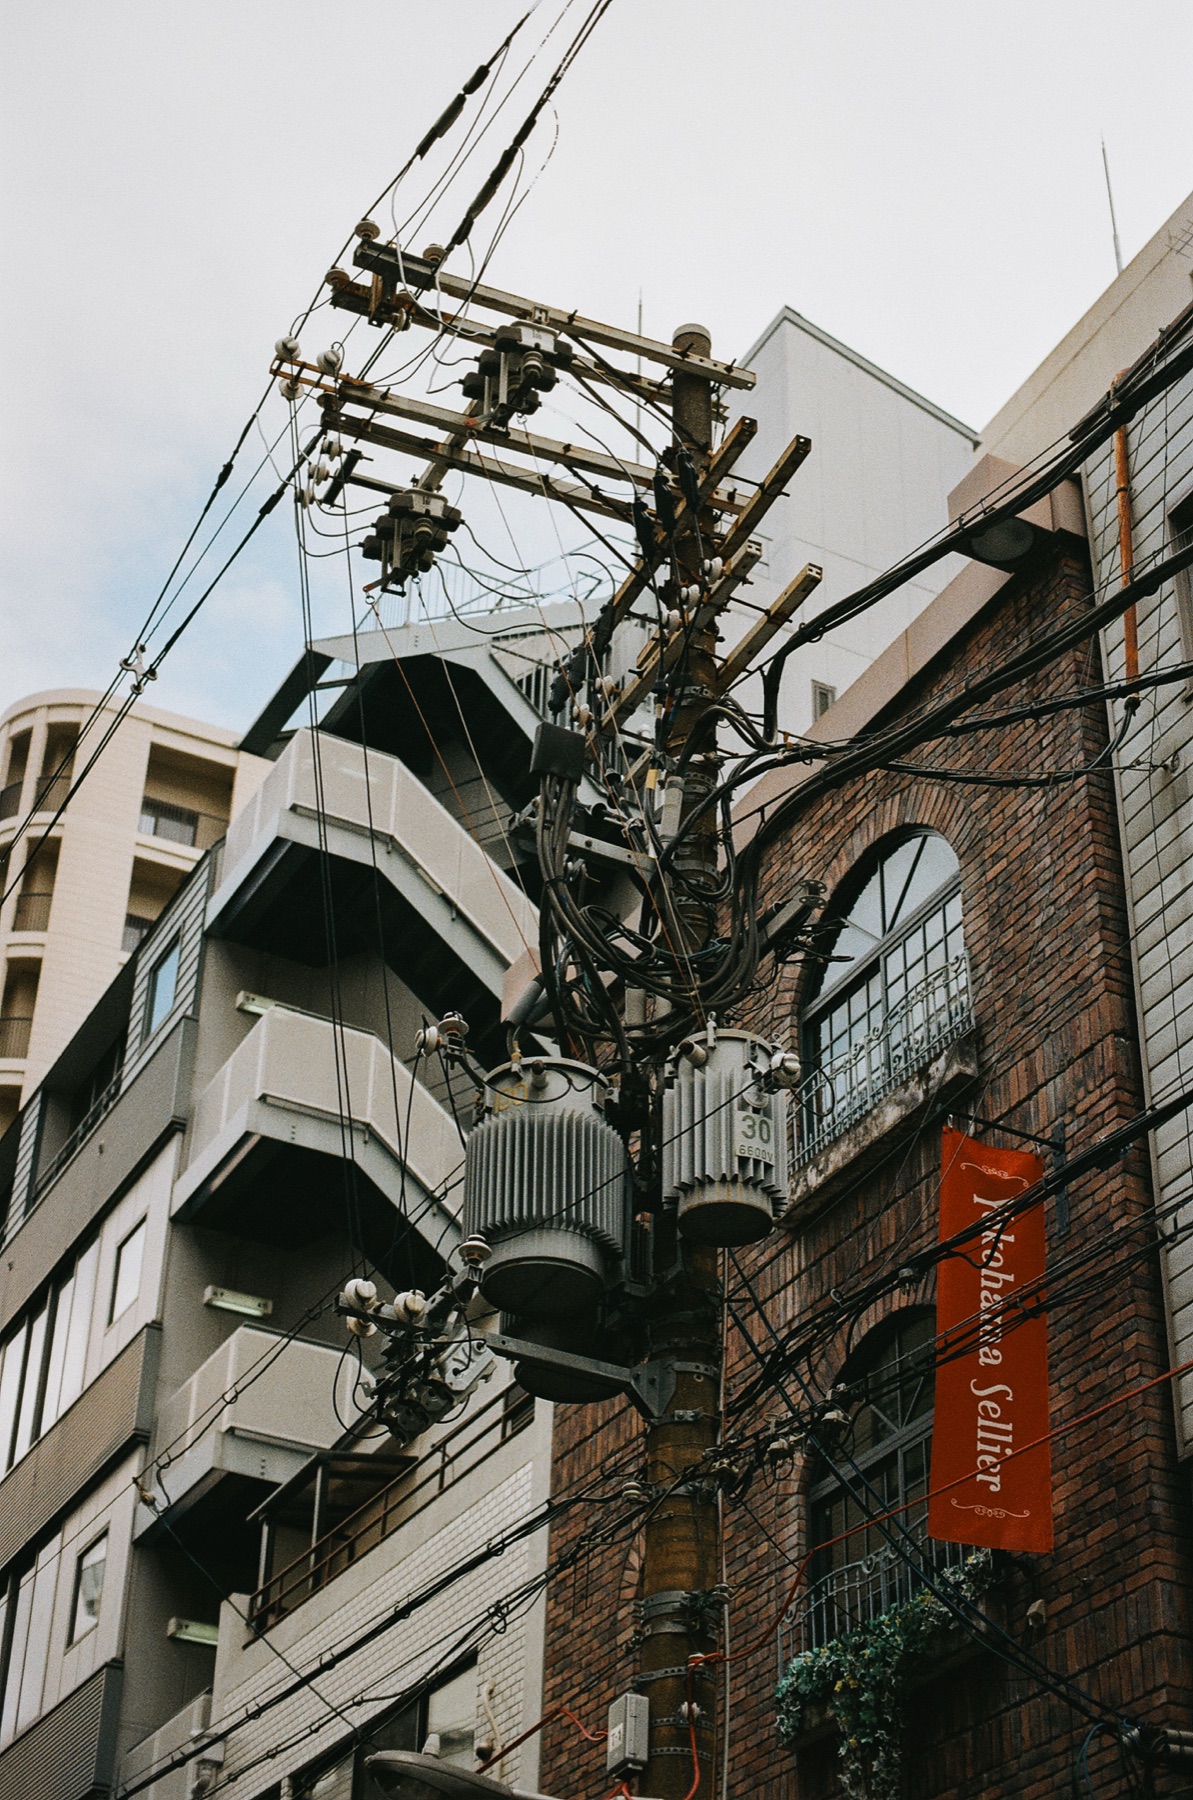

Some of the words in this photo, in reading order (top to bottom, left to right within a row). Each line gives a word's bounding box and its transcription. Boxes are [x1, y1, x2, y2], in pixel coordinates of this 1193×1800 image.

[741, 1114, 771, 1144] 30
[739, 1144, 773, 1162] 6600V
[969, 1378, 1014, 1492] Sellier
